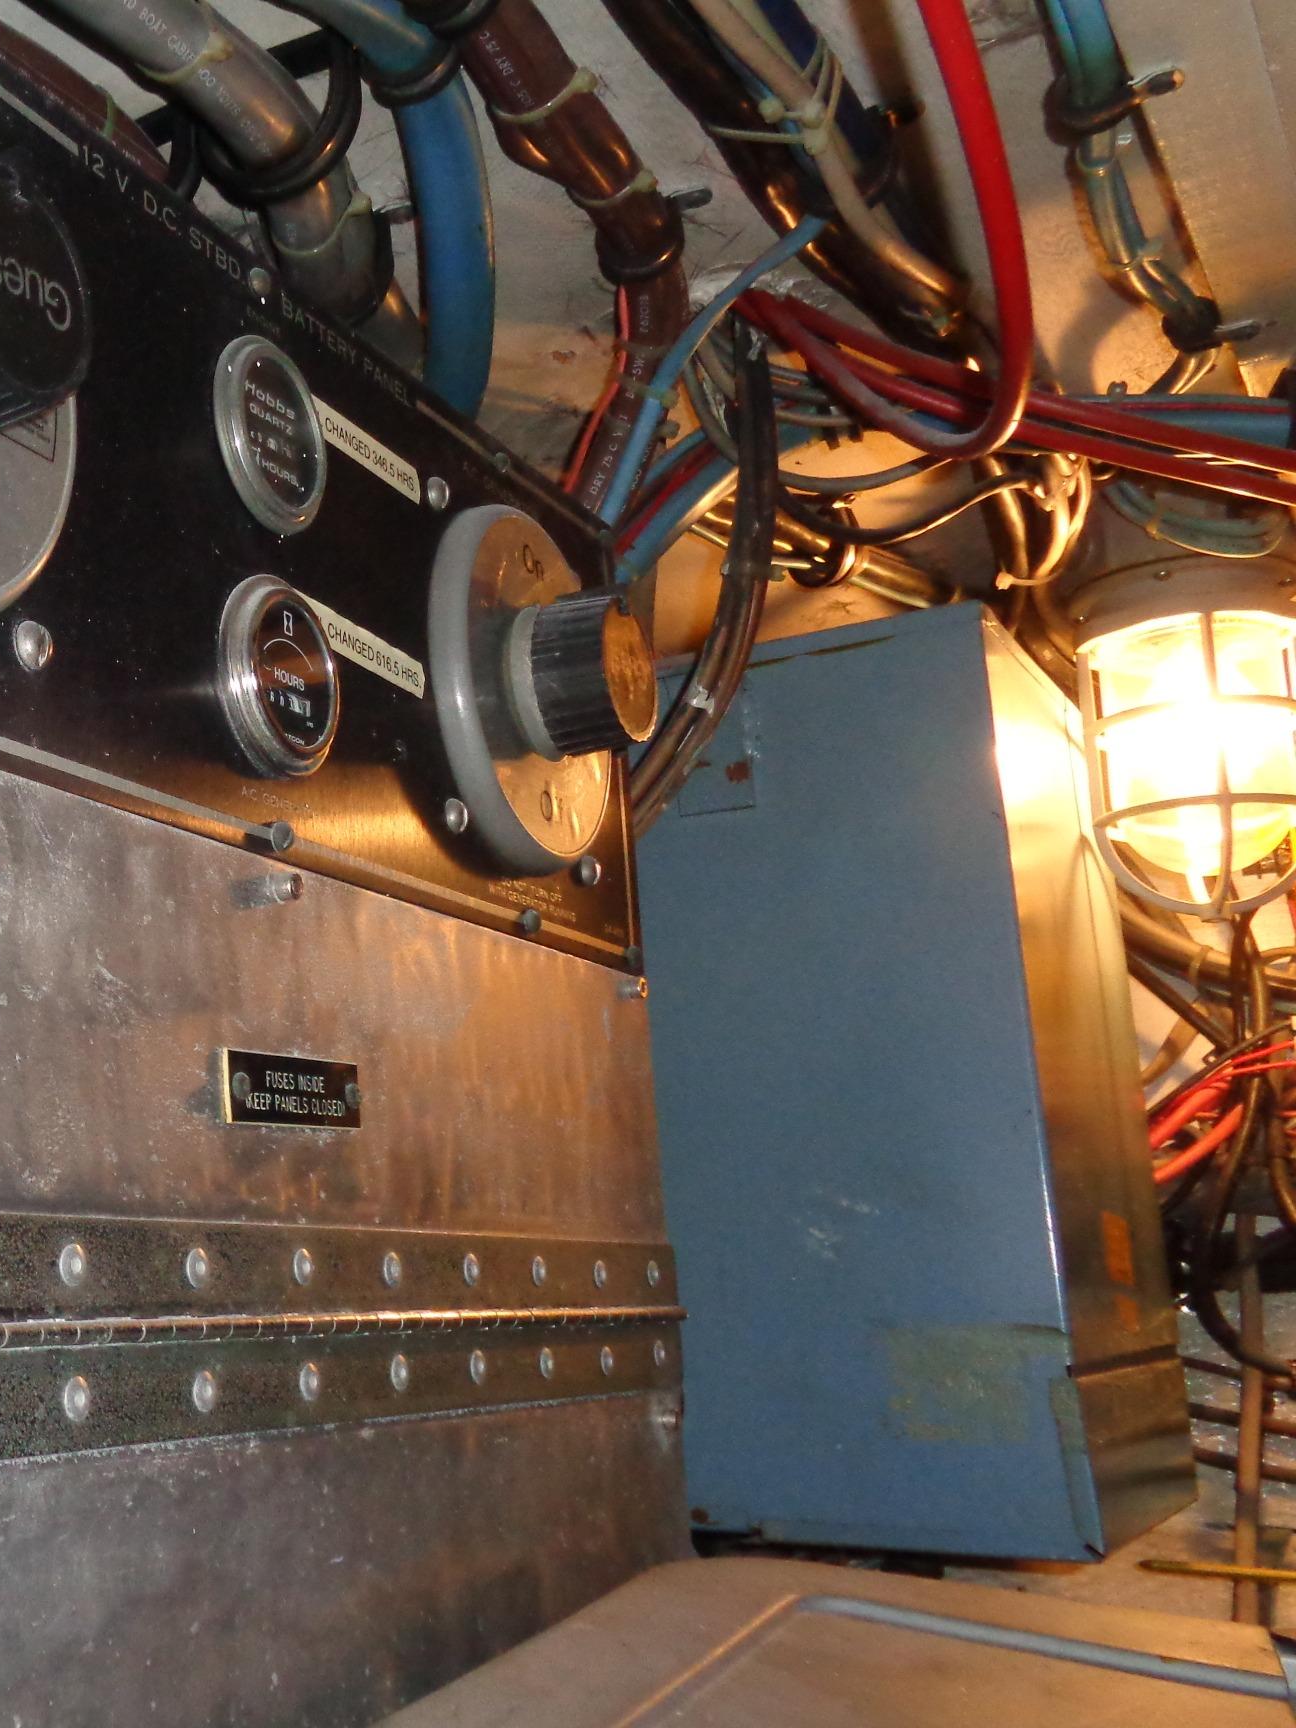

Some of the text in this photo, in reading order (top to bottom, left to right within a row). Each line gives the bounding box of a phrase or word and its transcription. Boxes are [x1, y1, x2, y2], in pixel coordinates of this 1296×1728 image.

[82, 144, 106, 179] 12
[280, 290, 357, 365] BATTERY
[363, 358, 412, 408] PANEL
[244, 379, 296, 421] Hobbs
[249, 402, 295, 436] QUARTZ
[324, 416, 371, 460] CHANGED
[371, 449, 396, 479] 346.5
[396, 467, 418, 494] HRS.
[522, 543, 546, 583] On
[327, 622, 423, 690] CHANGED 616.5 HRS.
[273, 666, 306, 692] HOURS
[265, 1070, 326, 1094] FUSES INSIDE
[274, 1094, 309, 1115] PANELS
[311, 1097, 346, 1118] CLOSED)
